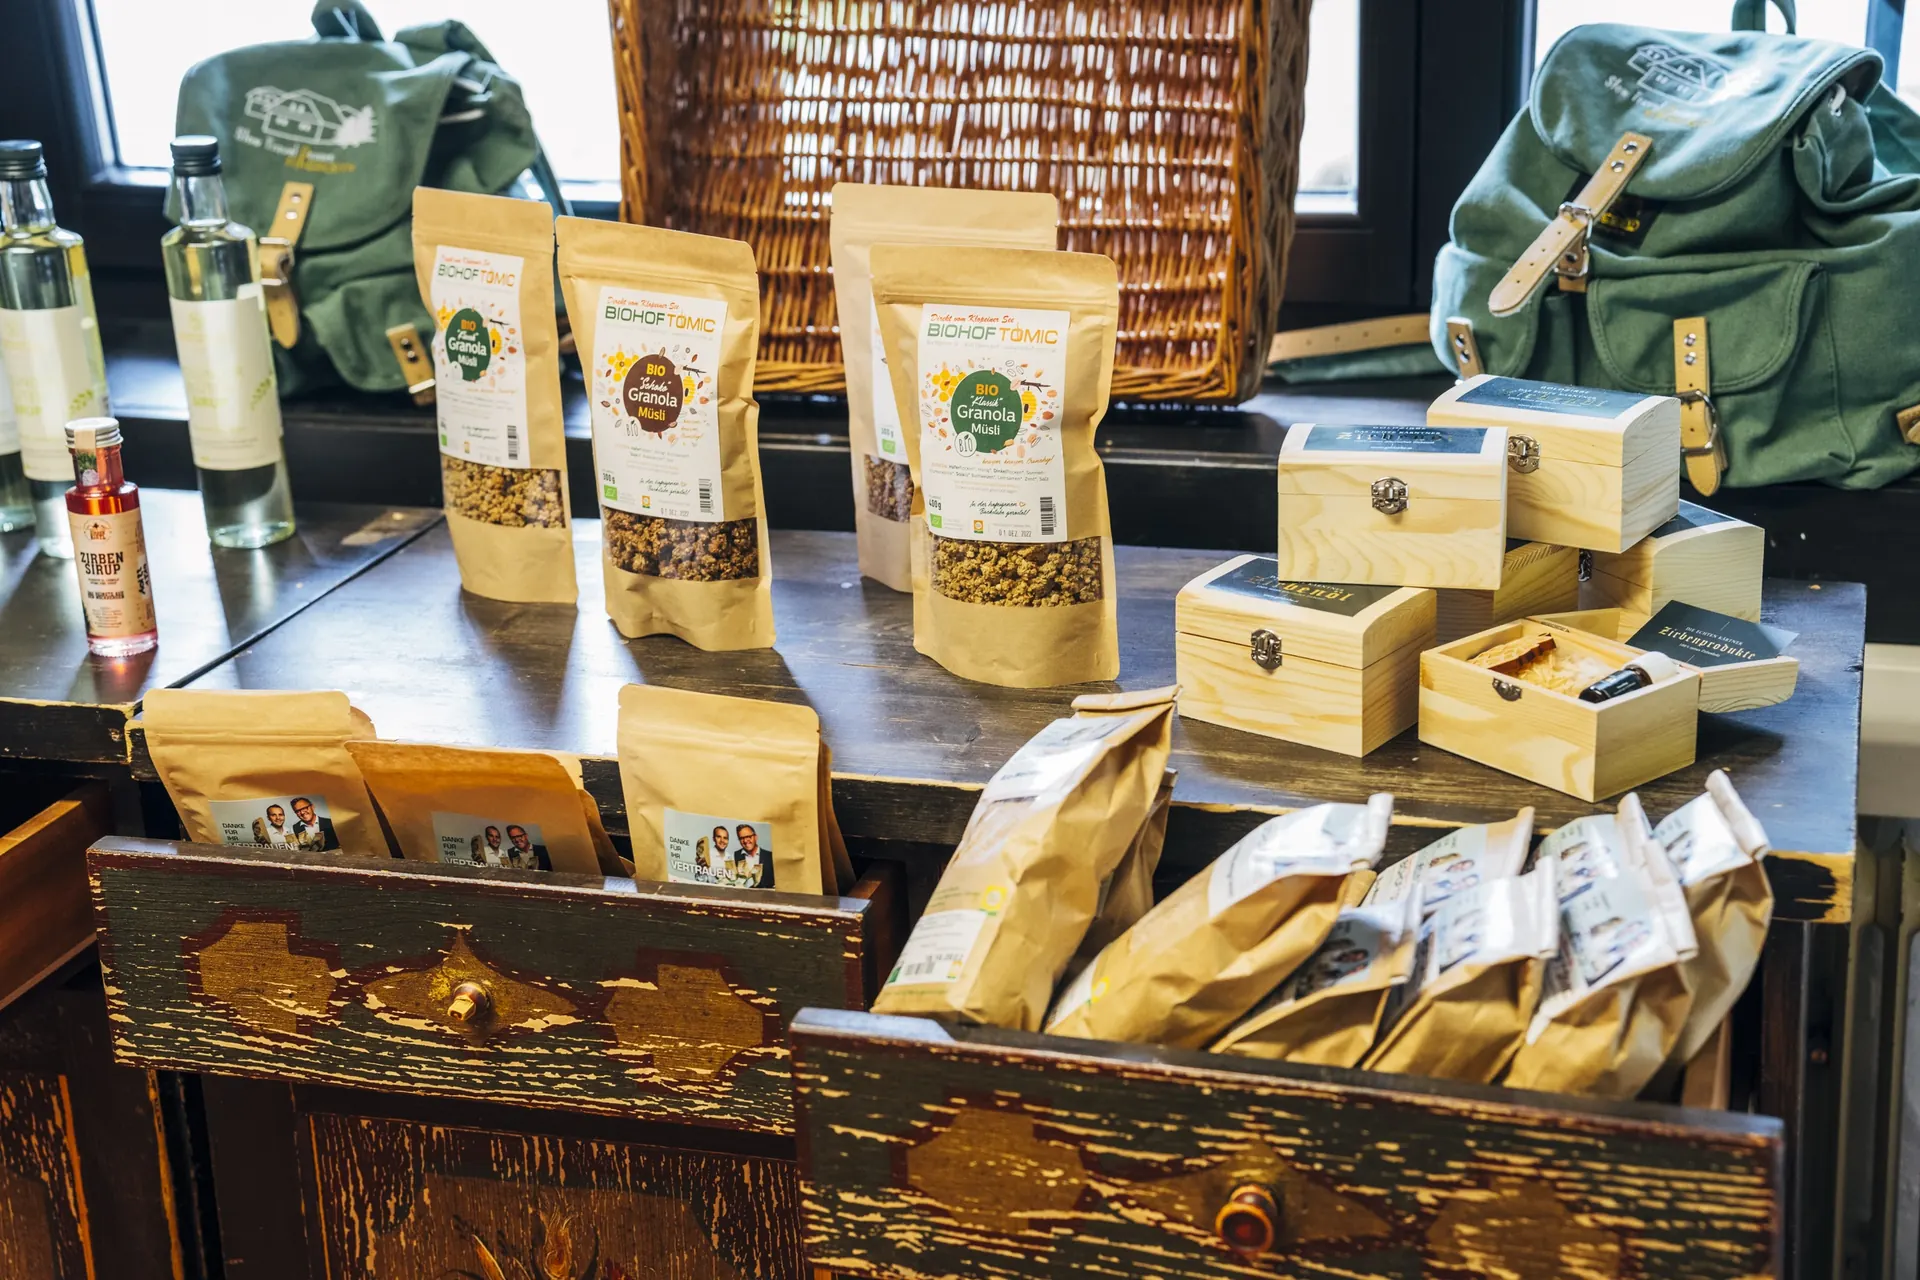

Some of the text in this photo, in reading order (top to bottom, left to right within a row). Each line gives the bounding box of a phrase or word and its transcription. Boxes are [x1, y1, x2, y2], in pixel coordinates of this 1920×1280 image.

[438, 264, 479, 280] BIOHOF
[480, 268, 515, 287] TOMIC
[461, 319, 476, 332] BIO
[605, 306, 666, 325] BIOHOF
[667, 310, 716, 333] TOMIC
[931, 314, 952, 322] Direkt
[968, 314, 999, 324] Klopeiner
[1001, 315, 1015, 324] See
[927, 322, 1058, 345] BIOHOF TOMIC
[448, 336, 487, 356] Granola
[458, 354, 478, 367] Müsli
[646, 364, 666, 376] BIO
[628, 387, 678, 407] Granola
[975, 384, 999, 396] BIO
[638, 406, 666, 421] Müsli
[957, 404, 1016, 422] Granola
[626, 420, 639, 437] BIO
[972, 423, 1000, 436] Müsli
[958, 434, 973, 453] BIO
[80, 552, 124, 564] ZIRBEN
[85, 564, 121, 575] SIRUP
[1696, 628, 1718, 639] ECHTEN
[1658, 626, 1756, 660] Zirbenprodukte
[670, 836, 689, 846] DANKE
[670, 860, 731, 878] VERTRAUEN
